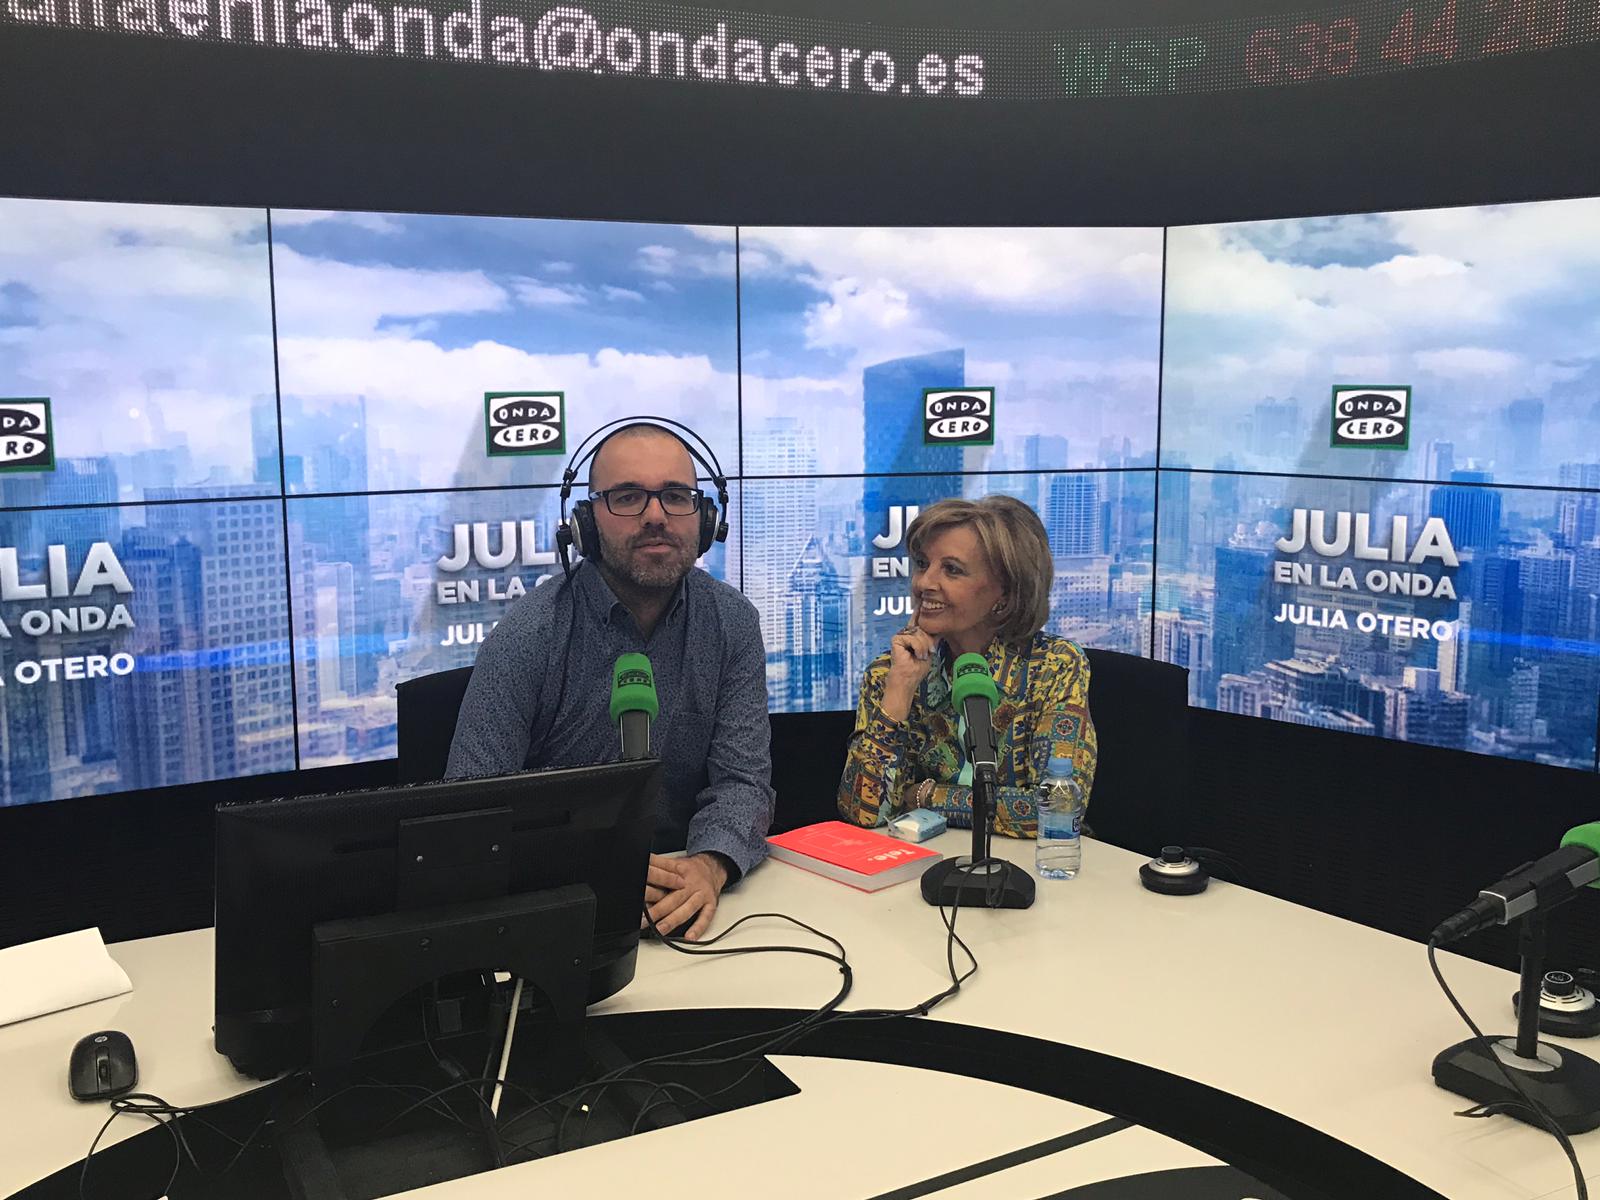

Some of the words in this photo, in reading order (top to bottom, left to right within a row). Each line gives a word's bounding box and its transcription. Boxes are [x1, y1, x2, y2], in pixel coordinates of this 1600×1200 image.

[1053, 36, 1207, 94] WSP
[1245, 17, 1359, 84] 638
[1380, 0, 1459, 65] 44
[498, 407, 551, 420] ONDA
[933, 401, 982, 413] ONDA
[1344, 401, 1396, 413] ONDA
[2, 416, 33, 429] DA
[936, 420, 982, 434] CERO
[1346, 422, 1395, 435] CERO
[502, 428, 552, 443] CERO
[5, 440, 35, 456] RO
[1274, 508, 1460, 568] JULIA
[0, 541, 134, 602] LIA
[871, 556, 910, 578] EN
[436, 579, 480, 605] EN
[487, 575, 527, 601] LA
[1274, 560, 1312, 586] EN
[1319, 565, 1359, 591] LA
[1365, 569, 1457, 600] ONDA
[873, 596, 915, 616] JUL
[20, 603, 136, 637] ONDA
[1273, 603, 1350, 631] JULIA
[1356, 612, 1453, 642] OTERO
[440, 621, 499, 647] JUL
[14, 652, 135, 685] OTERO
